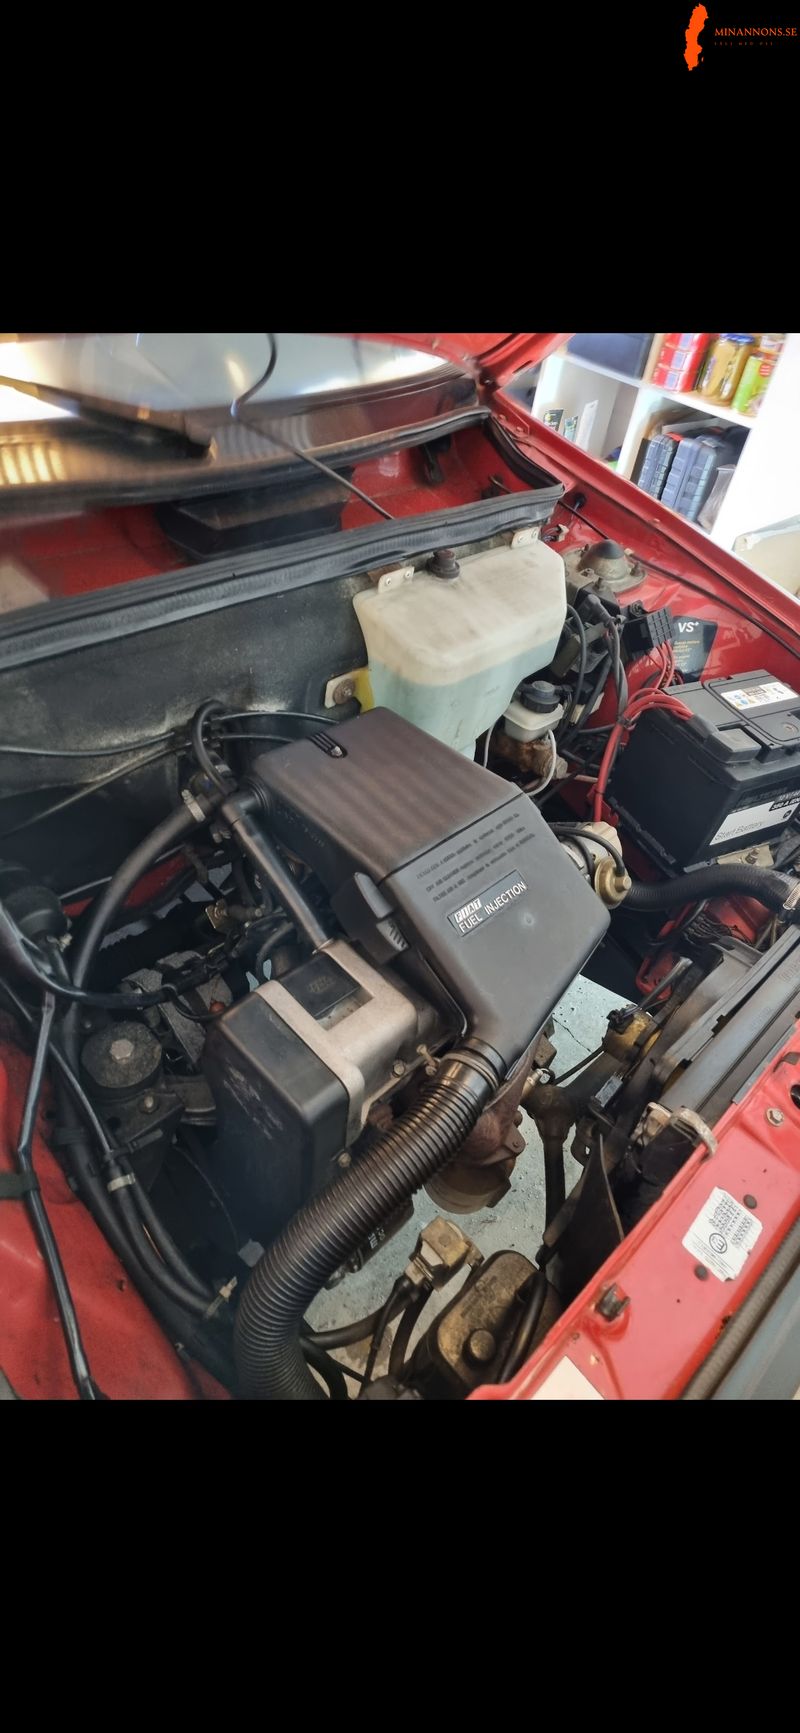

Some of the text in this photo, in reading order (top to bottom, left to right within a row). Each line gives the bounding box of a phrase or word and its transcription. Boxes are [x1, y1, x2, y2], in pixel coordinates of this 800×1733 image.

[454, 898, 482, 923] FIAT
[459, 881, 527, 933] FUEL INJECTION
